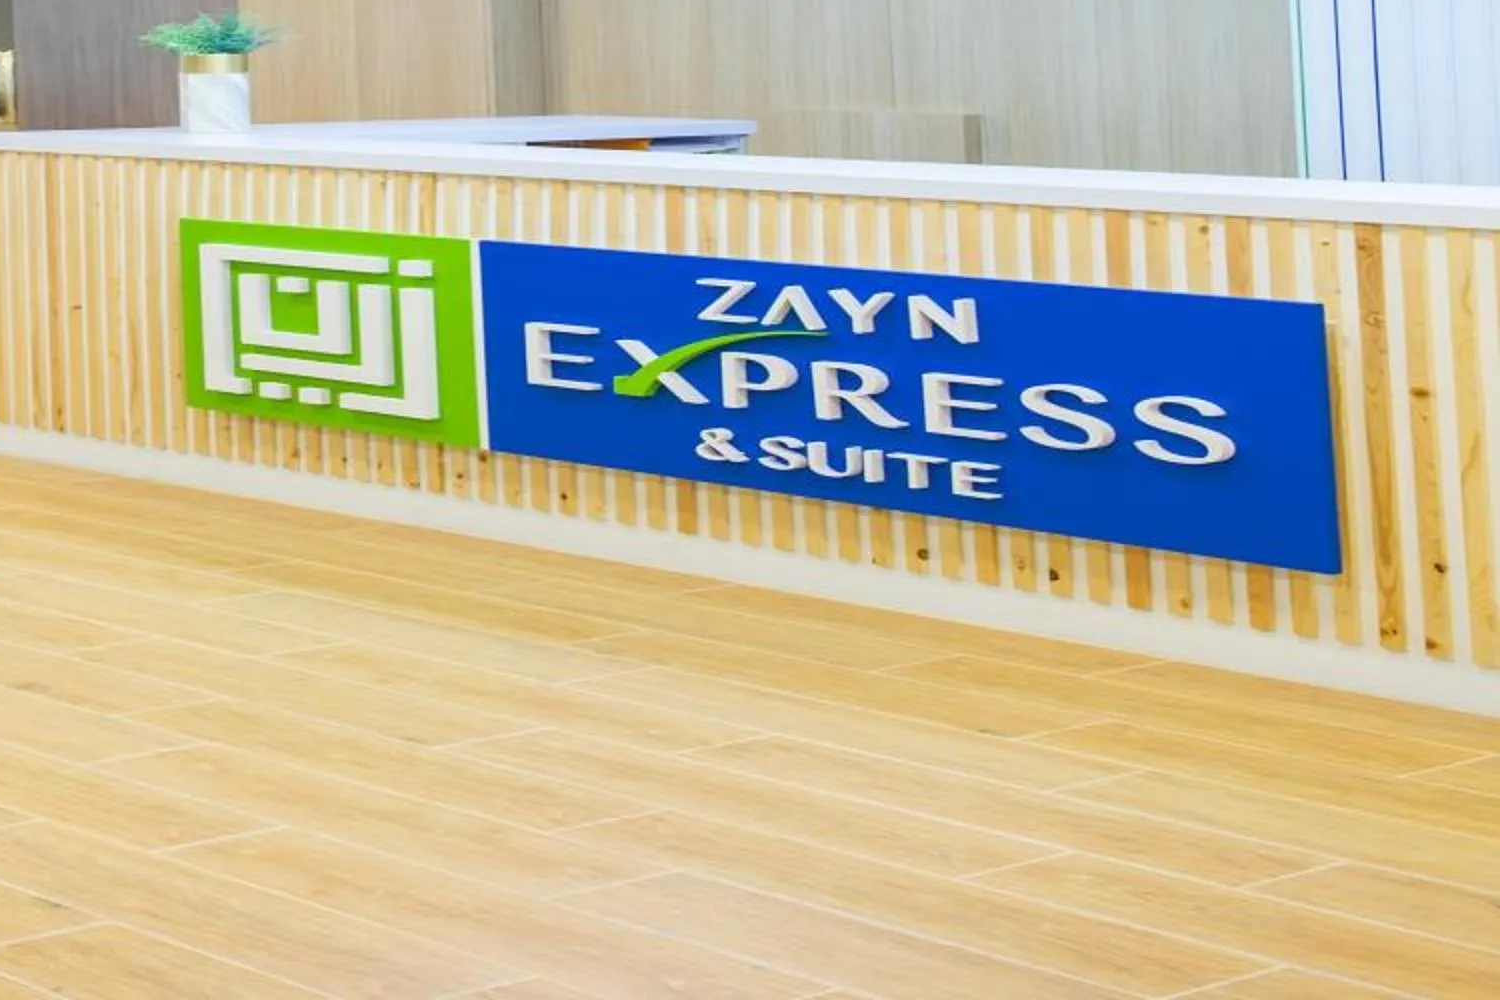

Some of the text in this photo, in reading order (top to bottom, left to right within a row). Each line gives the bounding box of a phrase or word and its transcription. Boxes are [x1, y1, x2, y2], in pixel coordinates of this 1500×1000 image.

[695, 277, 980, 345] ZAYN
[523, 321, 1236, 466] EXPRESS
[757, 435, 1002, 500] SUITE
